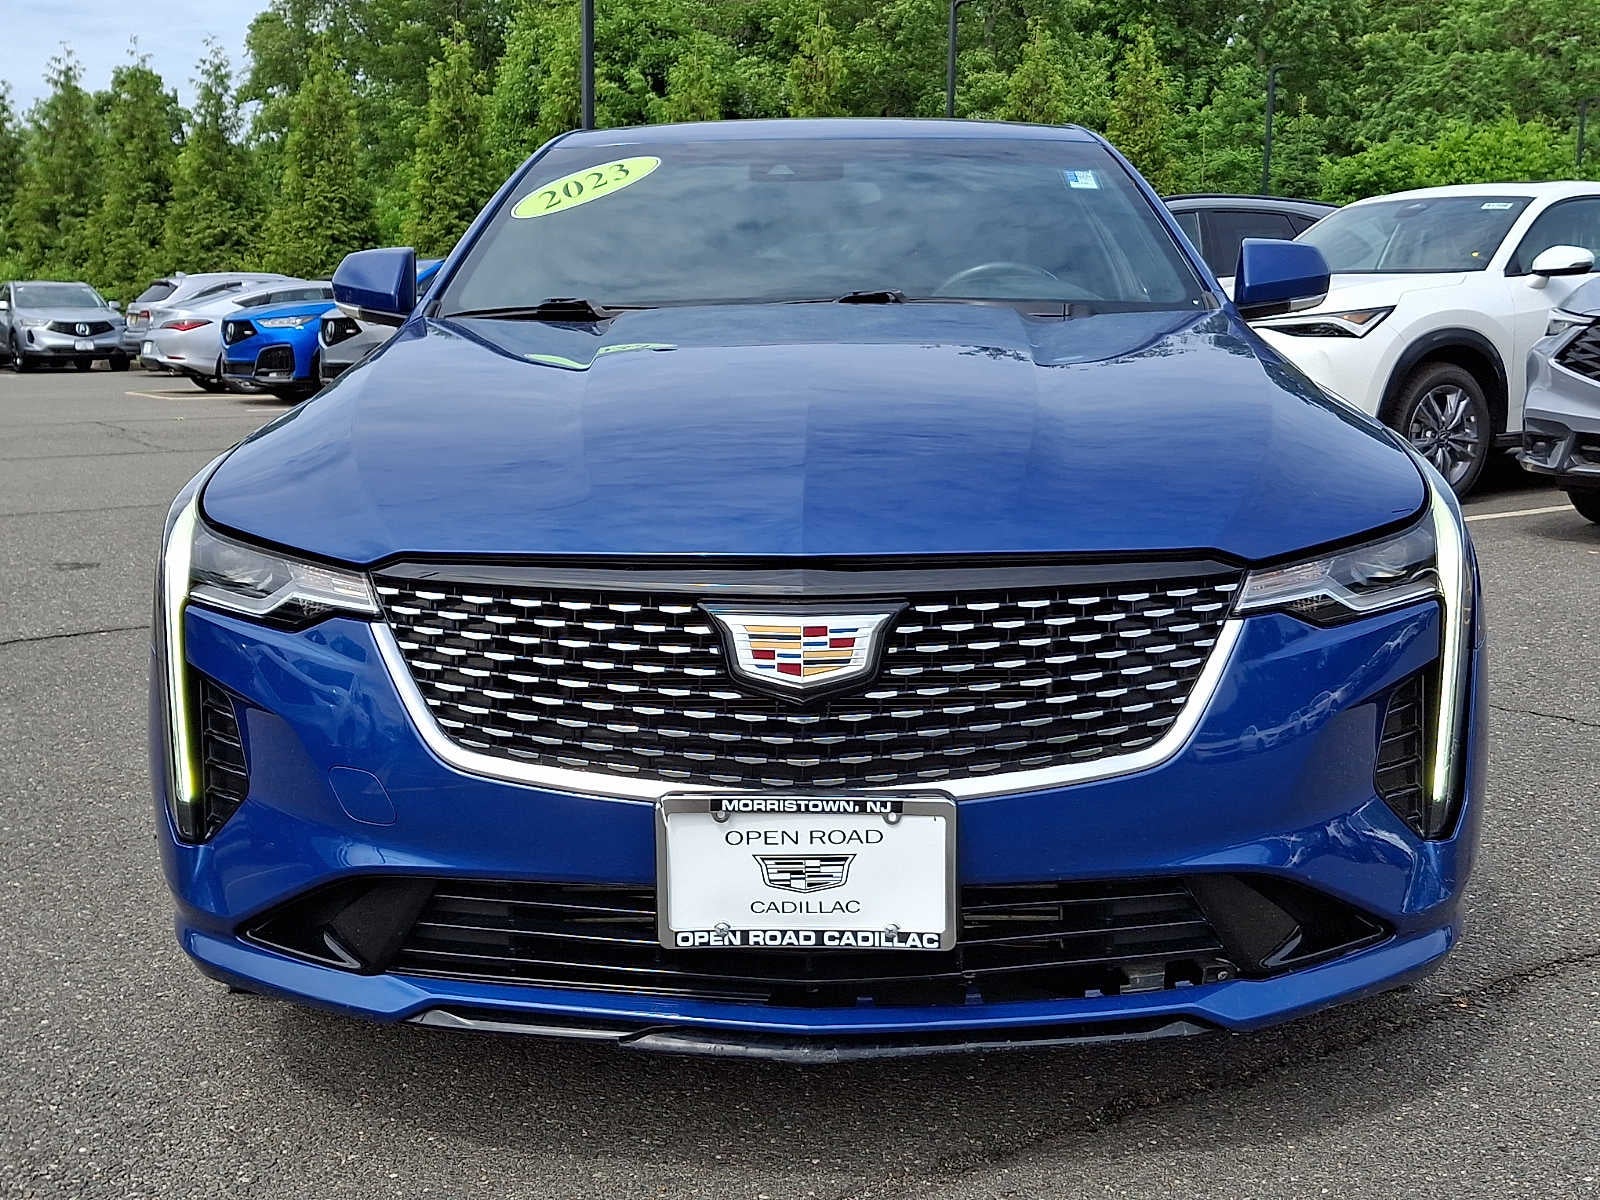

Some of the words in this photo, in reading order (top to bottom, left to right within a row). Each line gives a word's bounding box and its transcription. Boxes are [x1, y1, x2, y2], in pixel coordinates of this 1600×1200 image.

[538, 164, 630, 209] 2023
[721, 799, 859, 813] MORRISTOWN,
[866, 800, 892, 813] NJ
[724, 830, 799, 846] OPEN
[809, 829, 884, 845] ROAD
[750, 900, 861, 914] CADILLAC
[676, 931, 741, 947] OPEN
[748, 931, 816, 947] ROAD
[823, 931, 940, 949] CADILLAC
